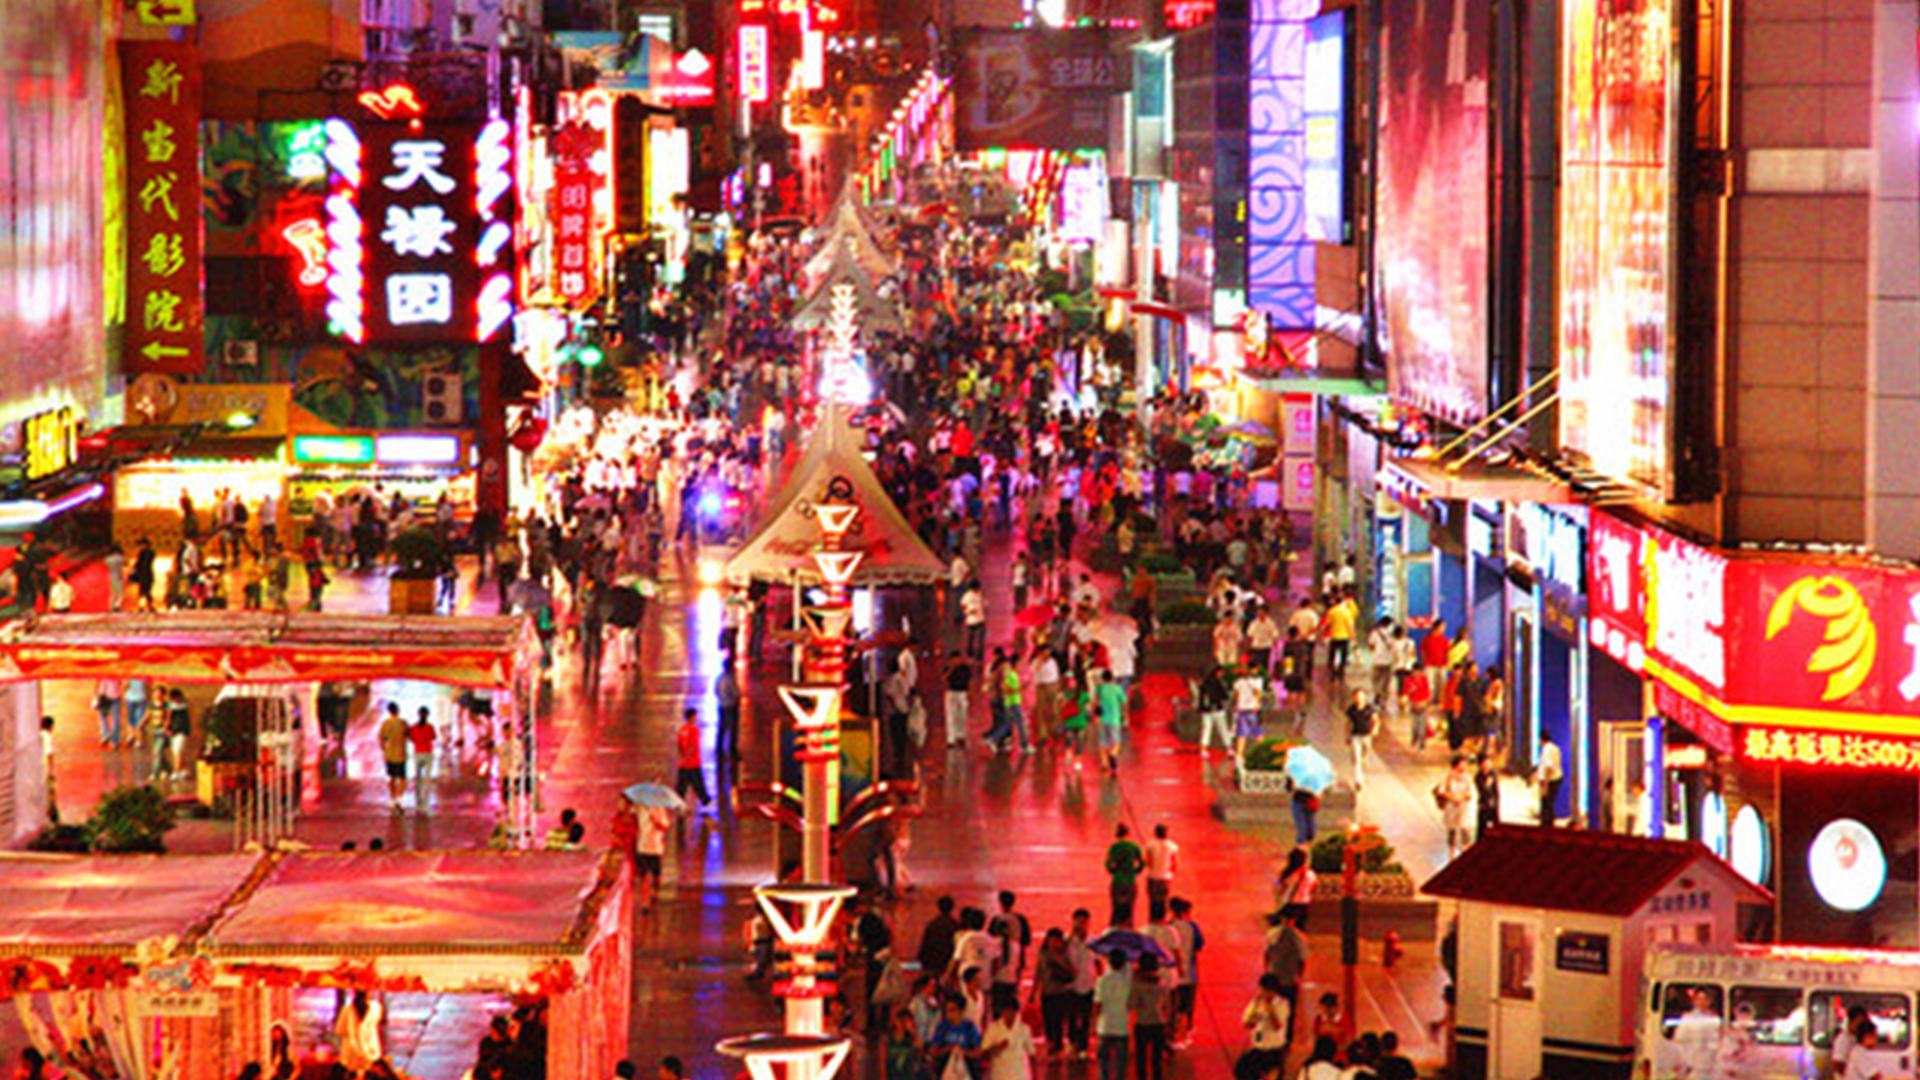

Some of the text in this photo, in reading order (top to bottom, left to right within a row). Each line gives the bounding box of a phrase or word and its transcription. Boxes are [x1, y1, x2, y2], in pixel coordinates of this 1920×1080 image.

[140, 58, 187, 331] 新当代影院
